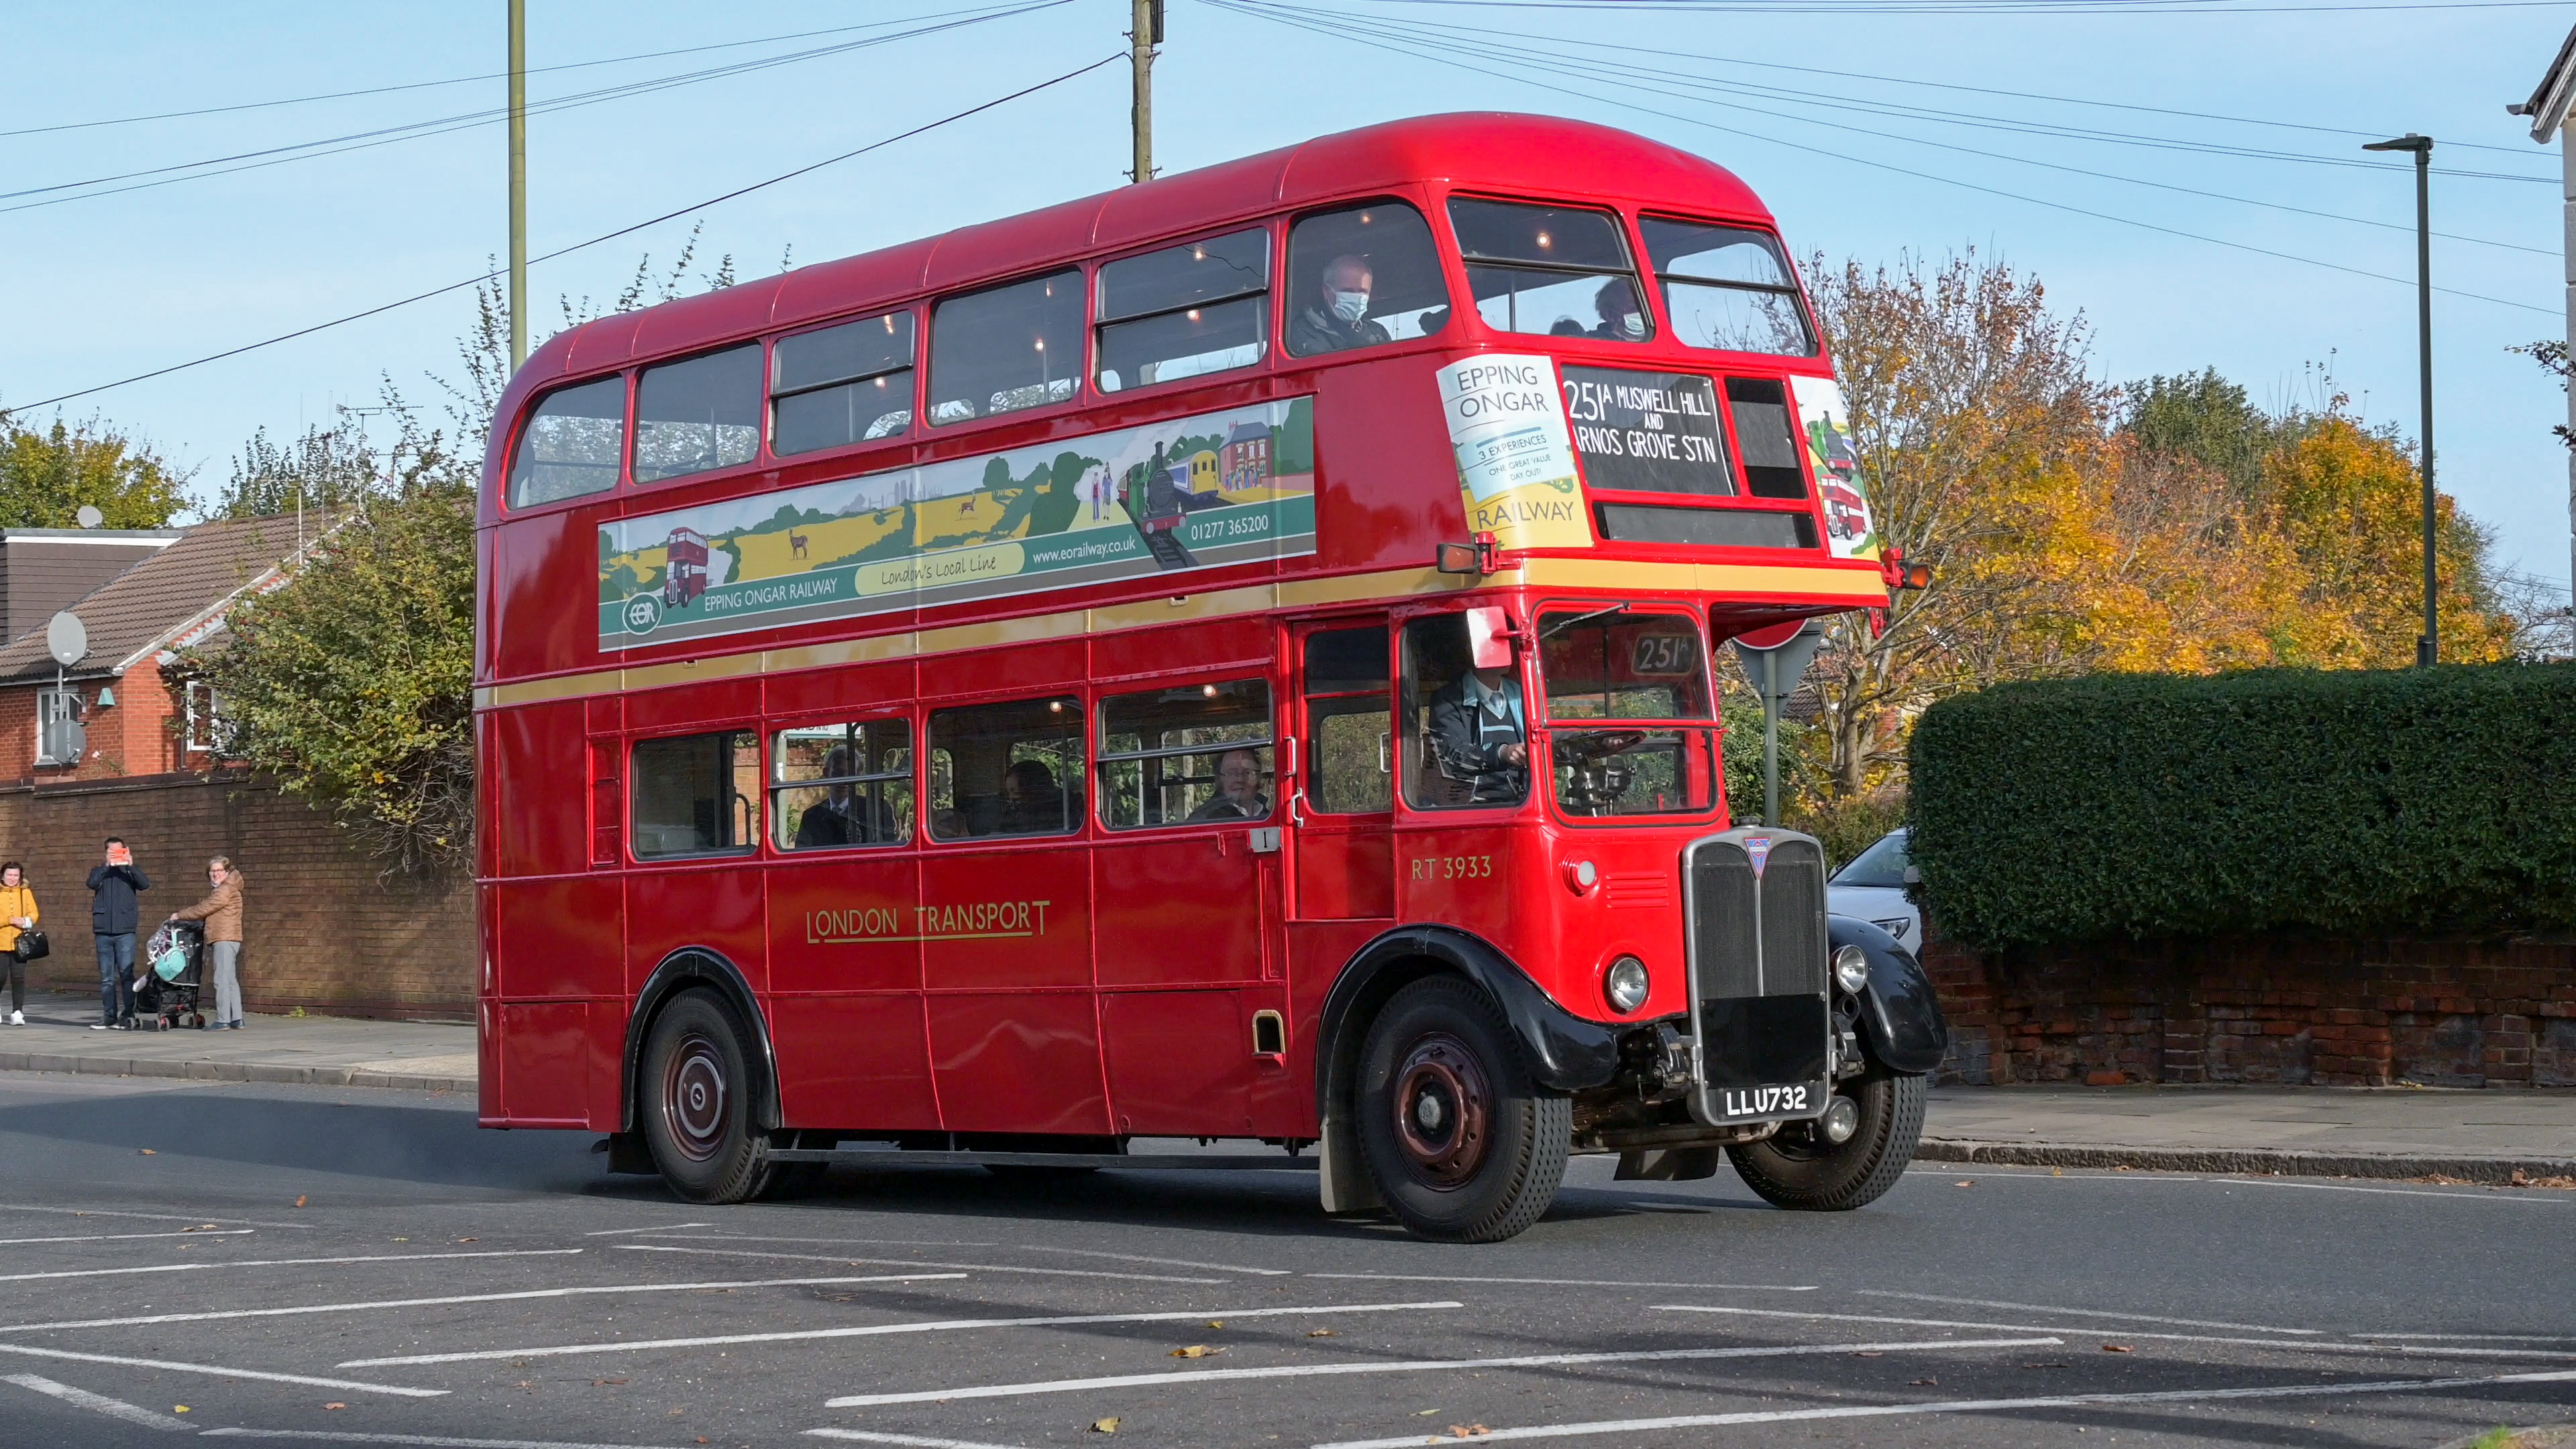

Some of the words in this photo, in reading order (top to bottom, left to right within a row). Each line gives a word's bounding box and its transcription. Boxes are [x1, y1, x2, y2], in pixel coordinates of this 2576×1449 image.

[1456, 365, 1538, 392] EPPING
[1460, 391, 1549, 417] ONGAR
[1616, 384, 1680, 414] MUSWELL
[1680, 391, 1711, 416] HILL
[1644, 412, 1664, 430] AND
[1478, 450, 1487, 461] 3
[1489, 435, 1547, 455] EXPERIENCES
[1626, 430, 1680, 461] GROVE
[1681, 435, 1717, 463] STN
[1489, 464, 1507, 476] ONE
[1509, 458, 1530, 470] GREAT
[1531, 453, 1552, 466] VALUE
[1510, 472, 1523, 481] DAY
[1191, 521, 1224, 541] 01277
[1228, 515, 1269, 535] 365200
[1477, 502, 1574, 529] RAILWAY
[1032, 535, 1136, 564] www.eorailway.co.uk
[881, 565, 932, 584] London's
[936, 557, 966, 576] Local
[970, 554, 996, 572] Line
[705, 592, 741, 612] EPPING
[745, 586, 786, 606] ONGAR
[790, 578, 837, 600] RAILWAY
[1412, 858, 1436, 880] RT
[1444, 855, 1491, 879] 3933
[806, 908, 898, 944] LONDON
[914, 900, 1051, 936] TRANSPORT
[1726, 1085, 1807, 1116] LLU732
